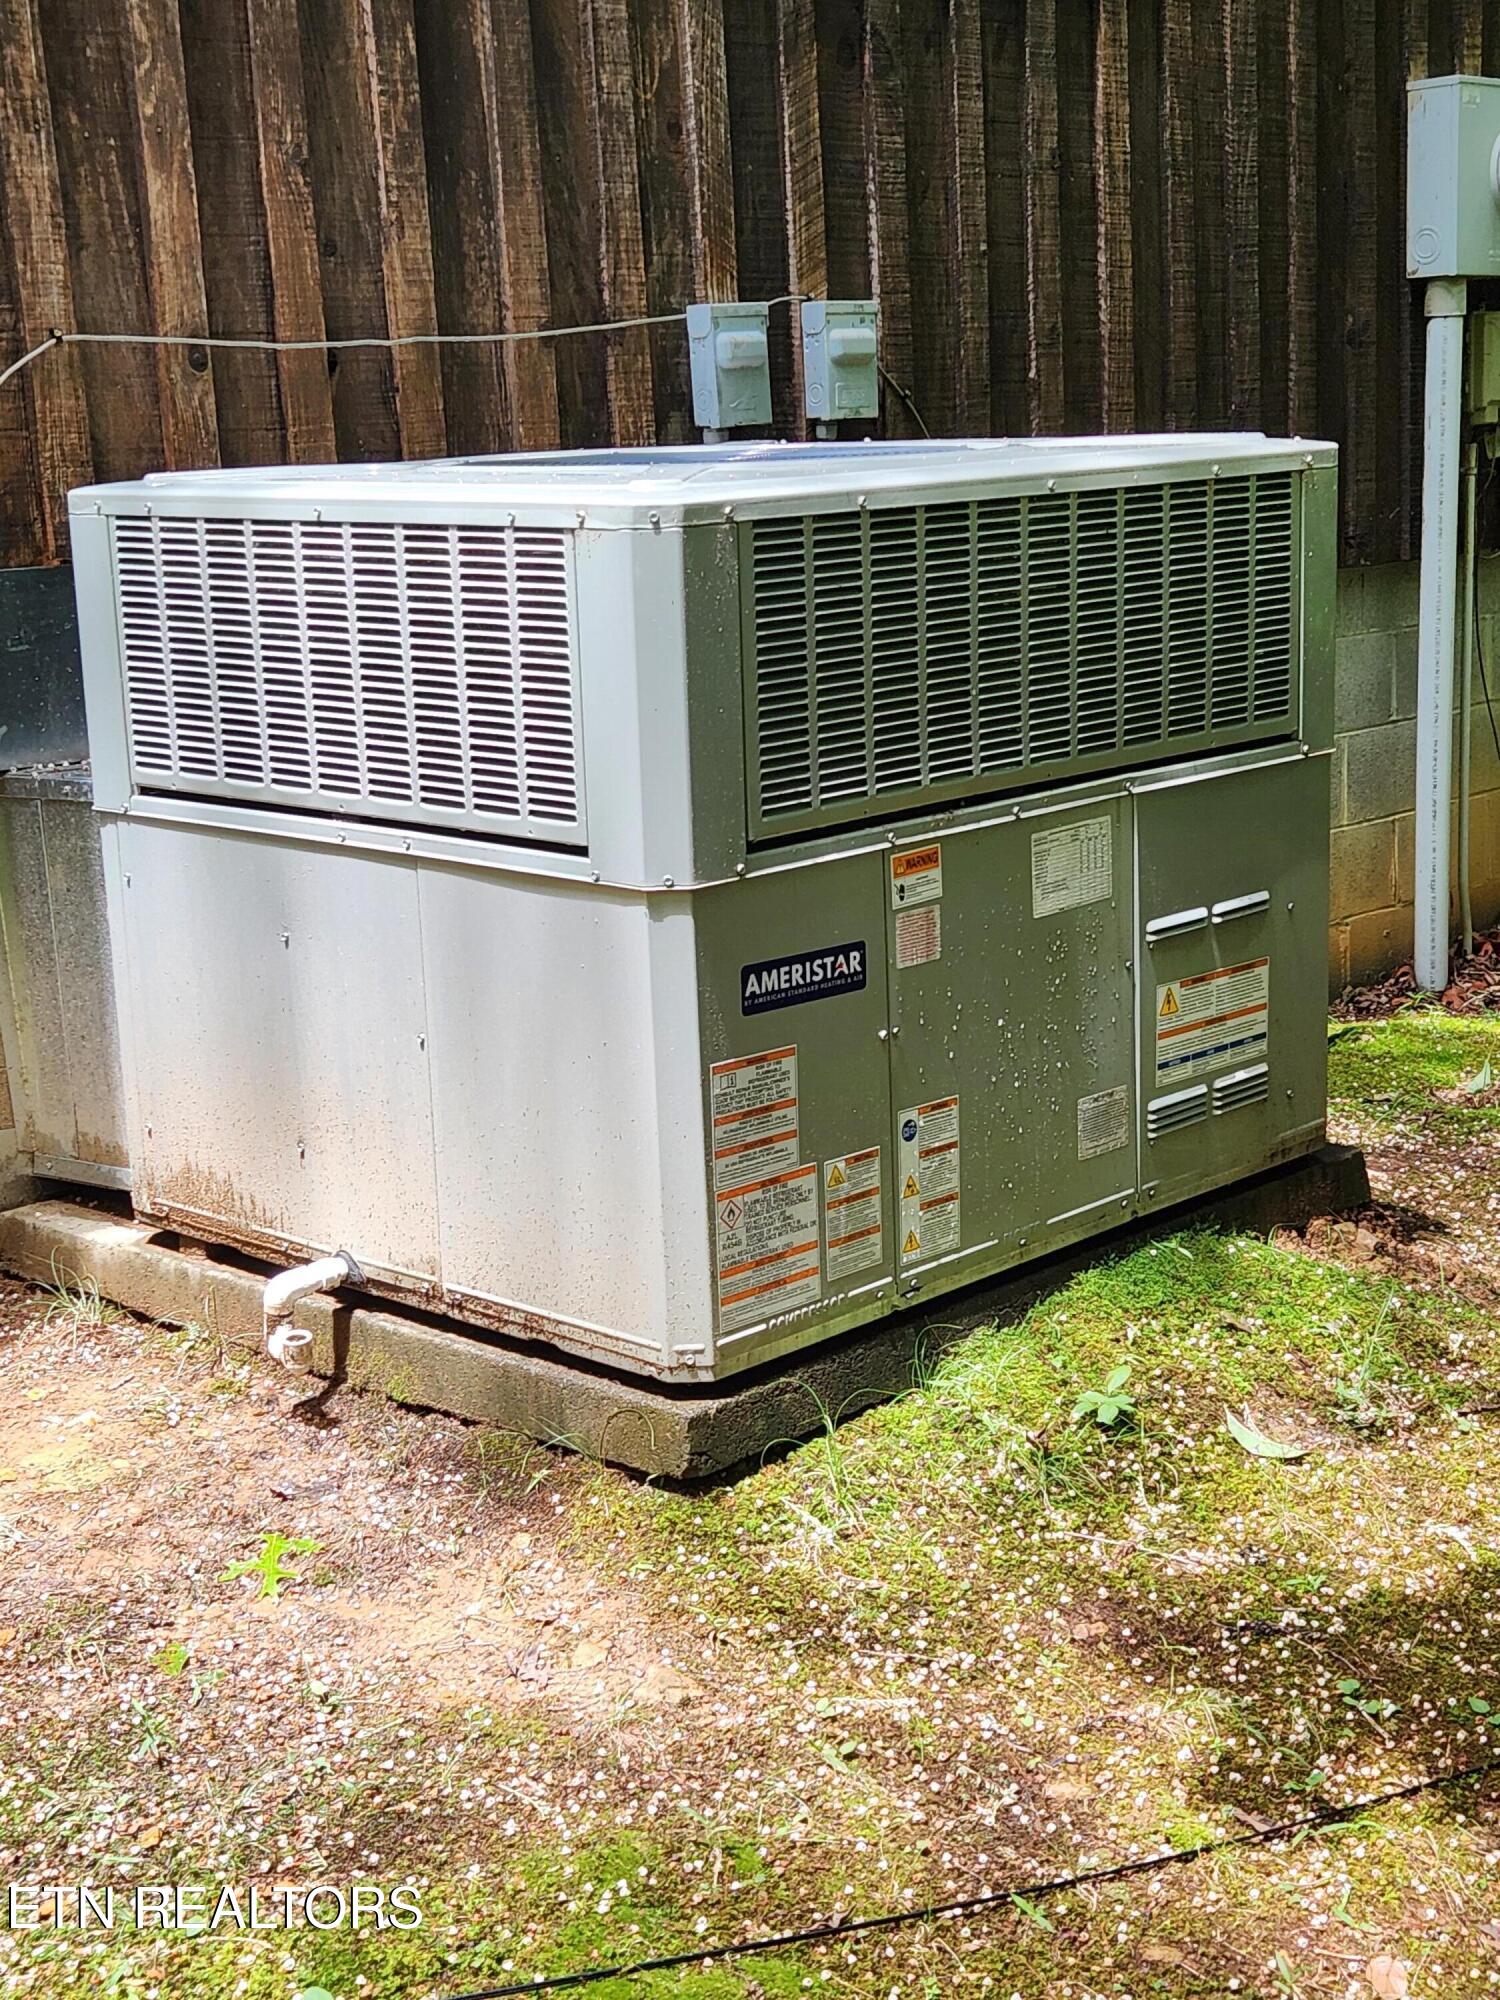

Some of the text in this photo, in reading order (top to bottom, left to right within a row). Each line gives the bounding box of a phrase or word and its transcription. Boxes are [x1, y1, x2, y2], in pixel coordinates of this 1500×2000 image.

[905, 851, 938, 870] WARNING
[745, 951, 862, 997] AMERISTAR
[754, 991, 785, 1004] AMERICAN
[788, 984, 817, 996] STANDARD
[820, 978, 845, 989] HEATING
[853, 974, 862, 982] AIR
[768, 1293, 846, 1330] COMPRESSOR
